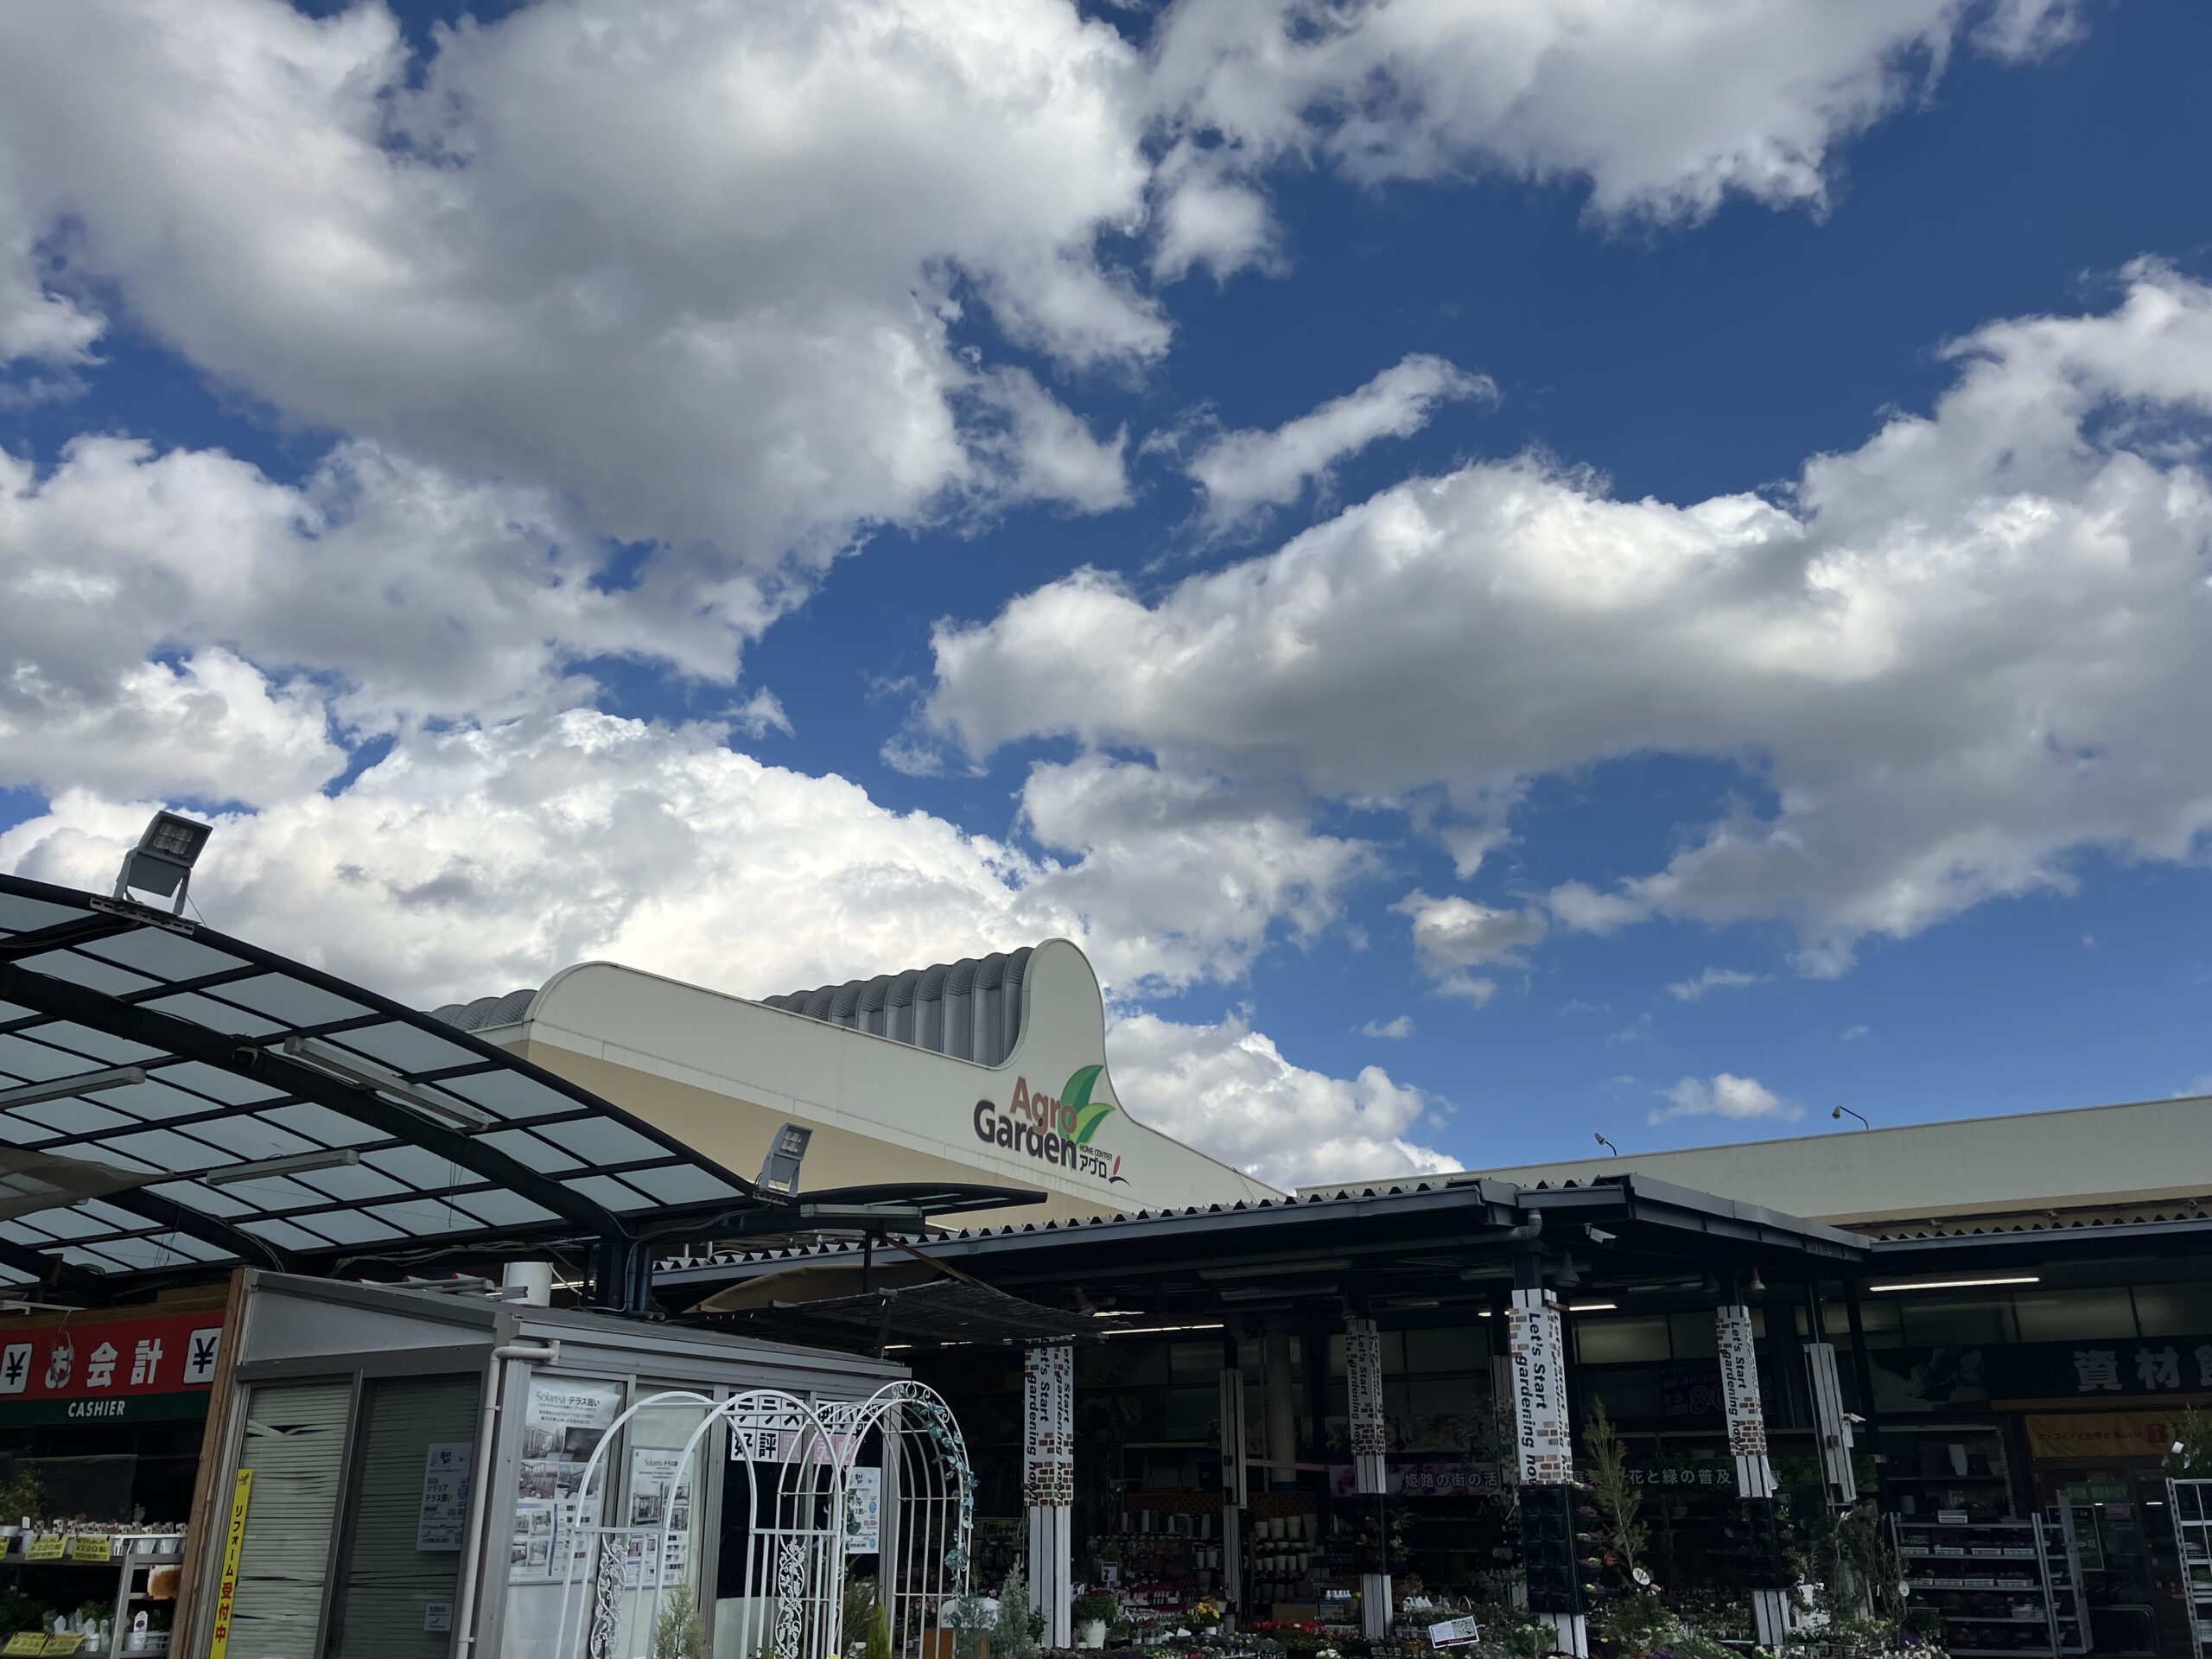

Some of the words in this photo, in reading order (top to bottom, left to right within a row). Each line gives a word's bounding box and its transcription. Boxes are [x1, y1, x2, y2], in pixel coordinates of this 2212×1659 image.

[1010, 1076, 1077, 1135] Agro
[974, 1099, 1077, 1170] Garden
[1080, 1145, 1094, 1155] HOME
[1095, 1149, 1113, 1161] CENTER
[1357, 1334, 1367, 1363] Let's
[1529, 1313, 1543, 1356] Let's
[1731, 1321, 1742, 1352] Let's
[45, 1338, 162, 1389] お会計
[1040, 1348, 1050, 1376] et's
[1359, 1366, 1368, 1395] Start
[1735, 1357, 1745, 1389] Start
[536, 1390, 566, 1404] Solarea
[568, 1396, 600, 1407] テラス囲い
[1040, 1382, 1050, 1421] Start
[1348, 1359, 1360, 1420] gardening
[1516, 1356, 1535, 1448] gardening
[1533, 1363, 1547, 1409] Start
[1722, 1352, 1738, 1415] gardening
[68, 1400, 125, 1418] CASHIER
[1027, 1375, 1039, 1456] gardening
[1405, 1472, 1498, 1488] 姫路の街の活
[214, 1505, 243, 1643] リフォーム受付中
